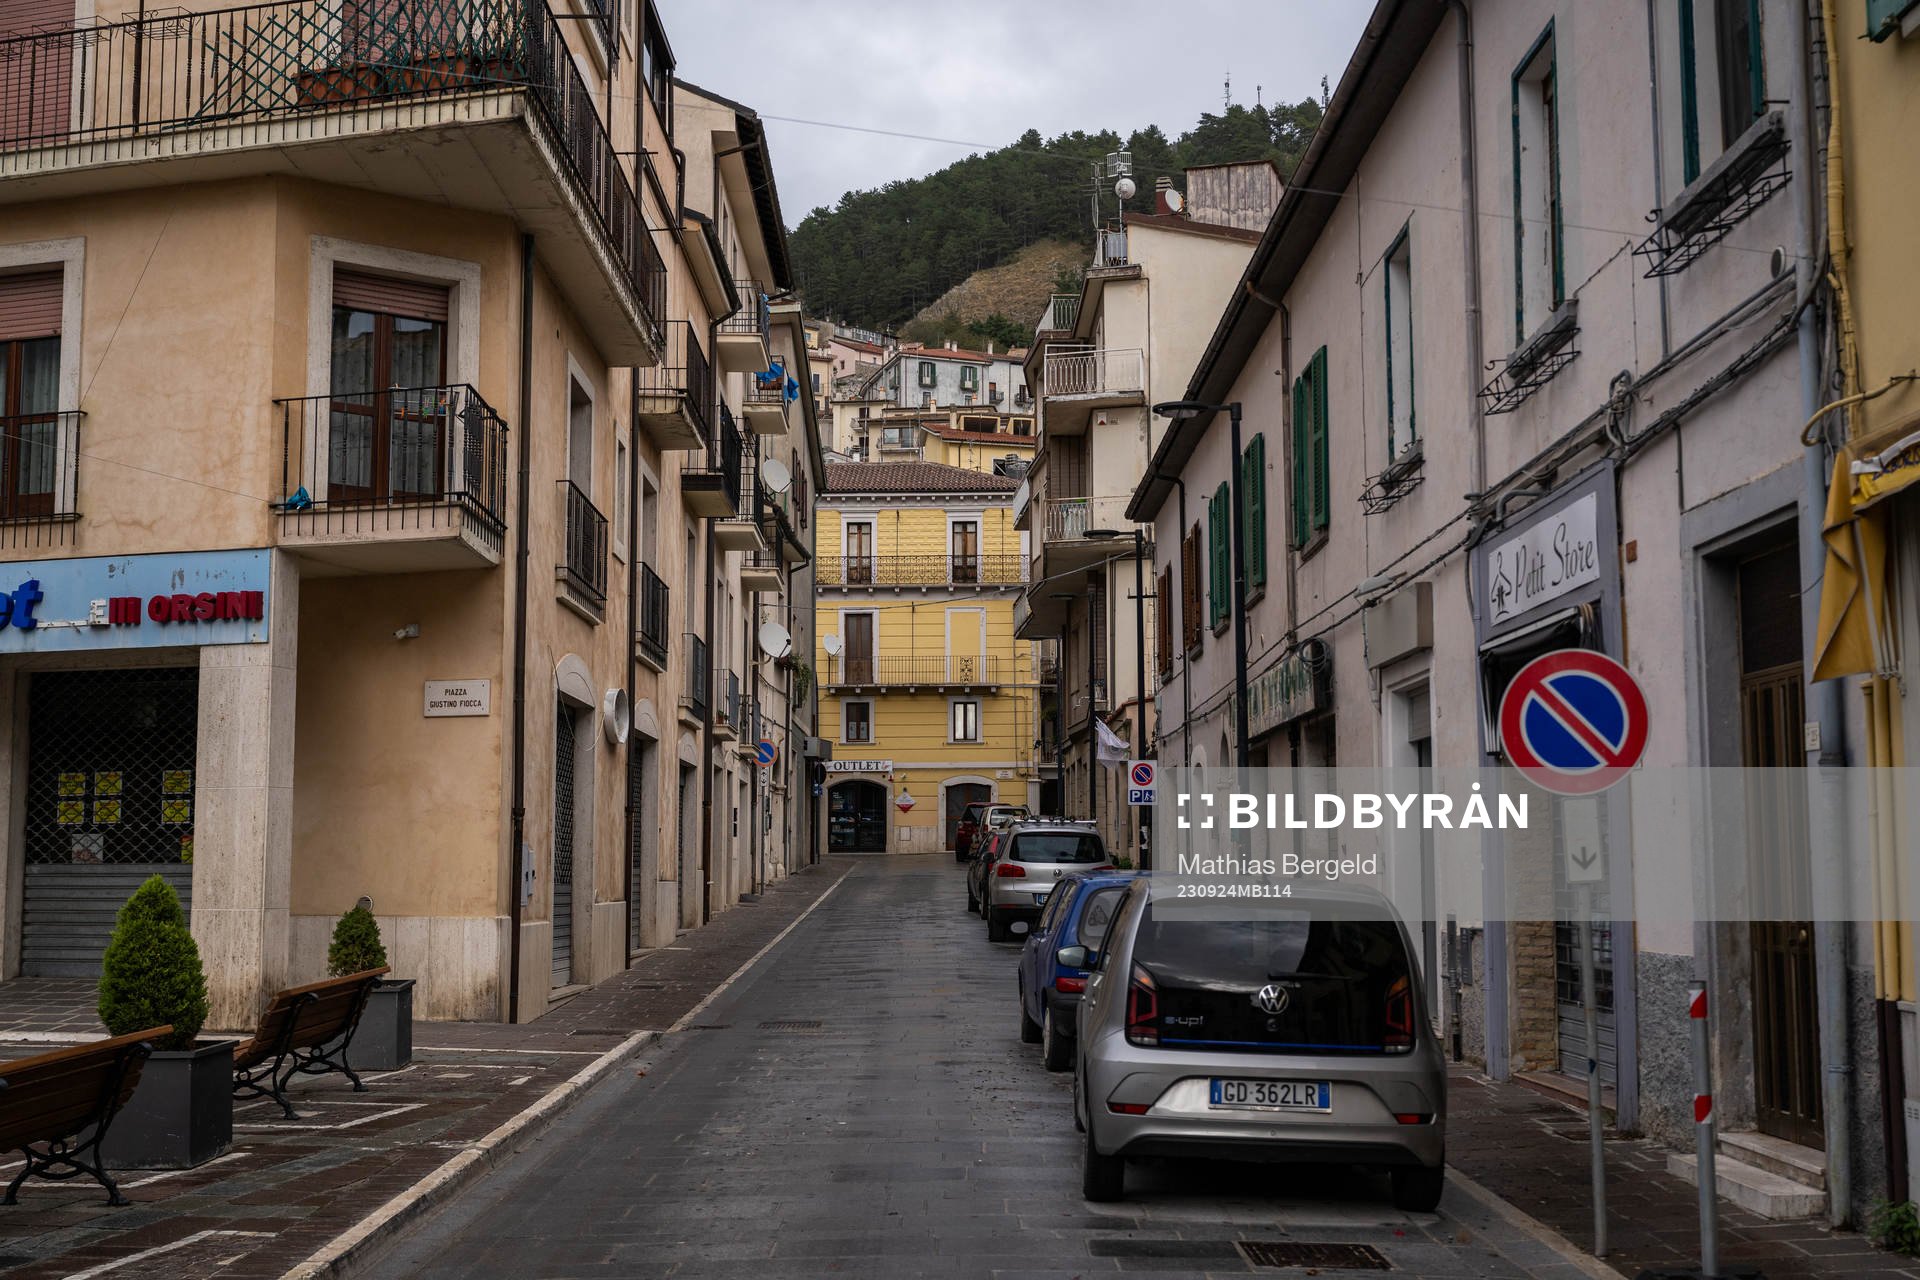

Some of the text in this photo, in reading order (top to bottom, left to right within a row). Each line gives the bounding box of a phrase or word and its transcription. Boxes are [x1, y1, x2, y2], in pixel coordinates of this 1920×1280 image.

[1515, 522, 1594, 604] Petit Store
[147, 590, 264, 623] ORSINI
[444, 688, 467, 696] PIAZZA
[429, 699, 482, 708] GIUSTINO FIOCCA
[833, 761, 881, 771] OUTLET
[1132, 791, 1141, 802] P
